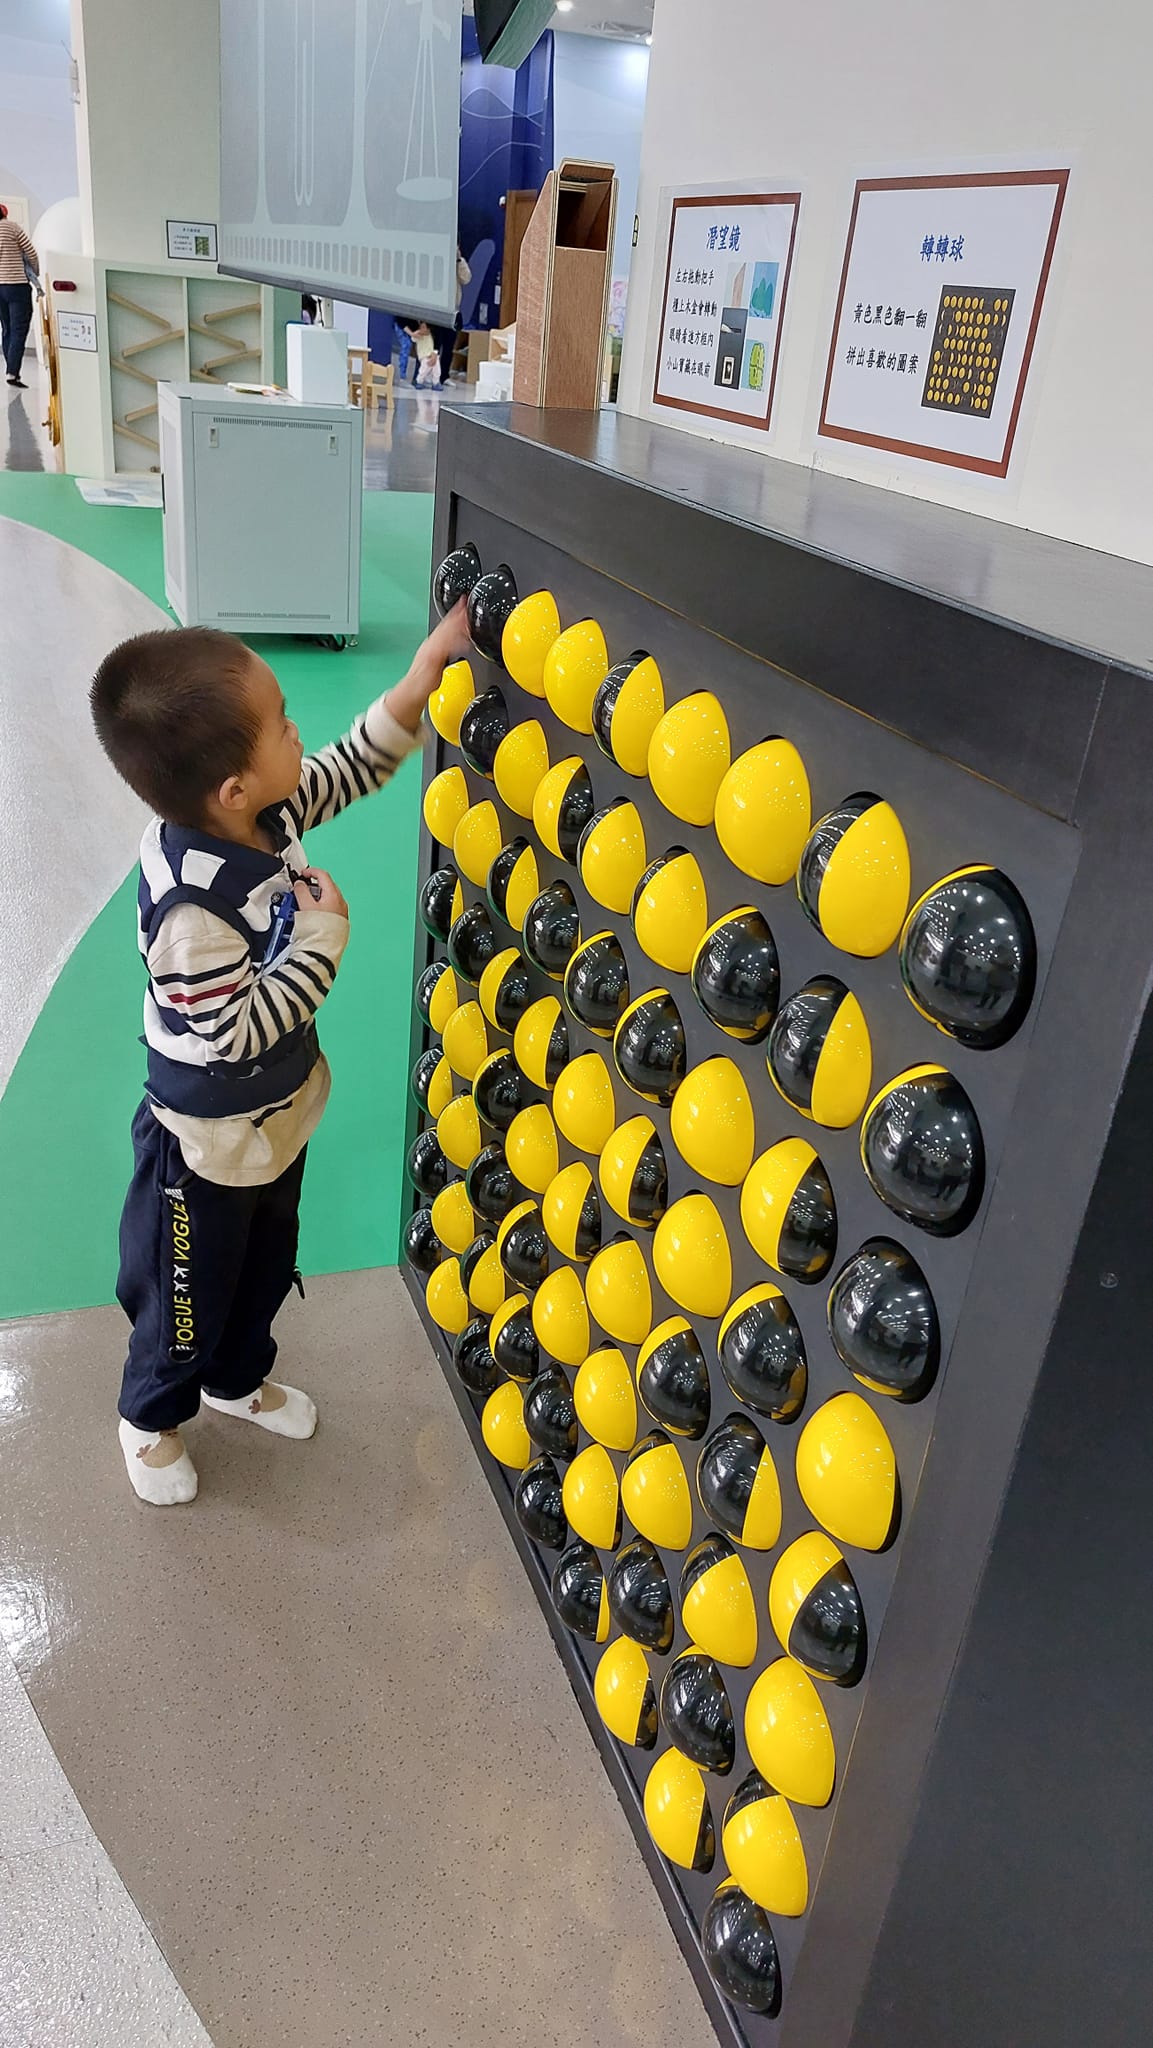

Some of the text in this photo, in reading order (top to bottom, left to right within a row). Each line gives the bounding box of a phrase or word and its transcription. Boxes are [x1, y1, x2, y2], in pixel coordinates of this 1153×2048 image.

[706, 225, 741, 252] 潛望鏡
[920, 235, 965, 262] 轉轉球
[853, 303, 928, 328] 黃色黑色翻一翻
[846, 346, 918, 374] 拼出喜歡的圖案
